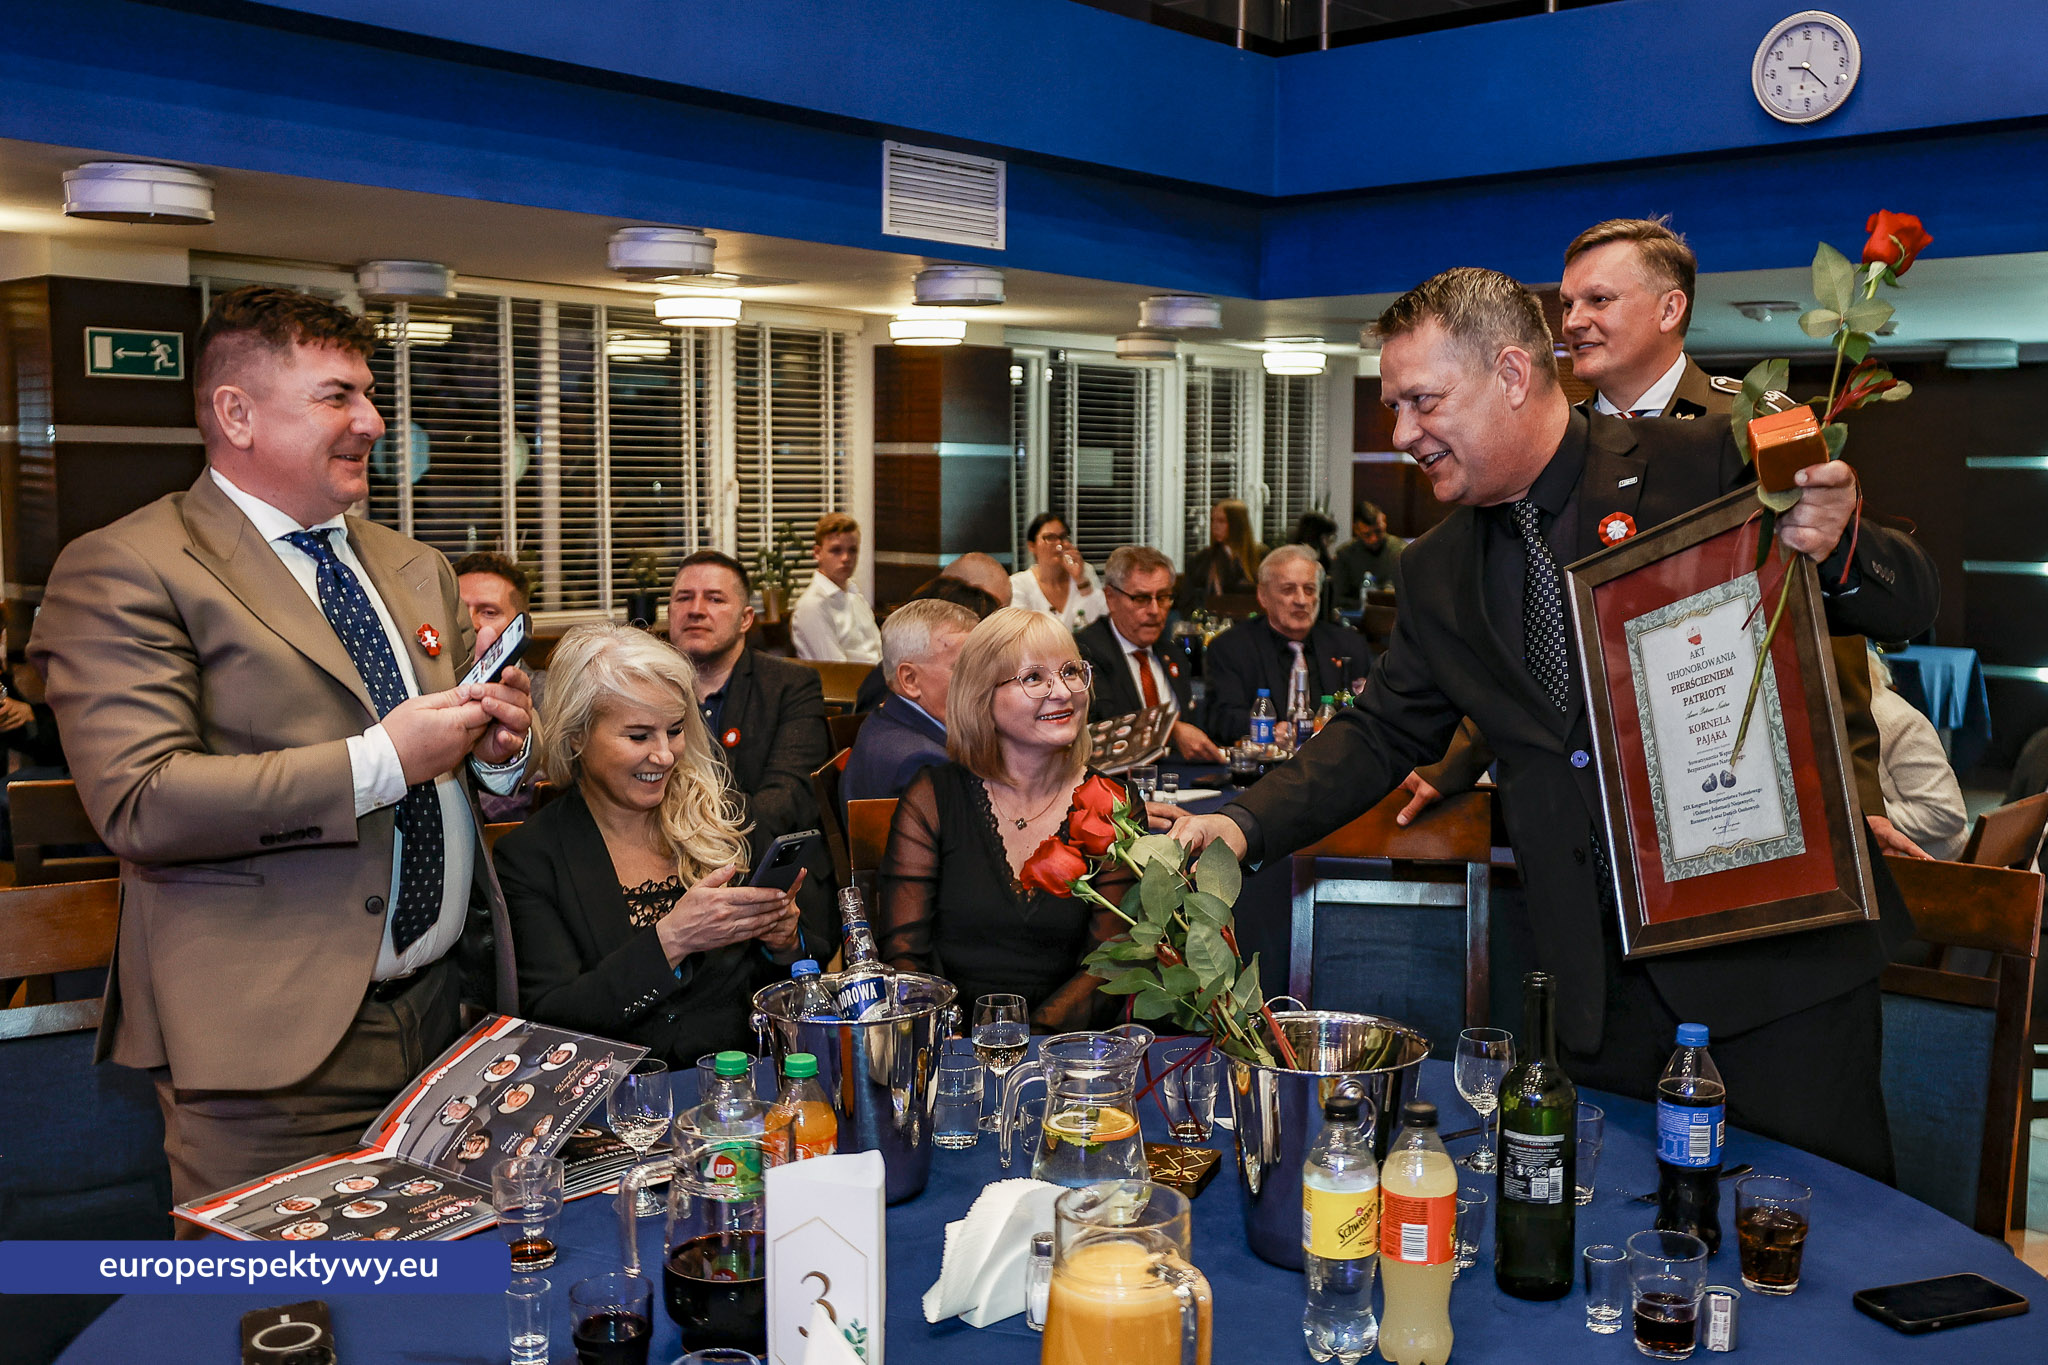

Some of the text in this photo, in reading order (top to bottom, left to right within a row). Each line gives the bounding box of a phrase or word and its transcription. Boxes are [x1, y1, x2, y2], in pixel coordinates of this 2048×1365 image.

[1666, 651, 1736, 681] UHONOROWANIA
[1690, 646, 1705, 659] AKT
[1671, 666, 1734, 695] PIERŚCIENIEM
[1683, 685, 1726, 706] PATRIOTY
[1688, 715, 1731, 734] KORNELA
[1696, 730, 1727, 746] PAJĄKA
[838, 982, 878, 1010] OROWA
[539, 1078, 609, 1156] PRZEDSIĘBIORCY
[798, 1271, 837, 1338] 3
